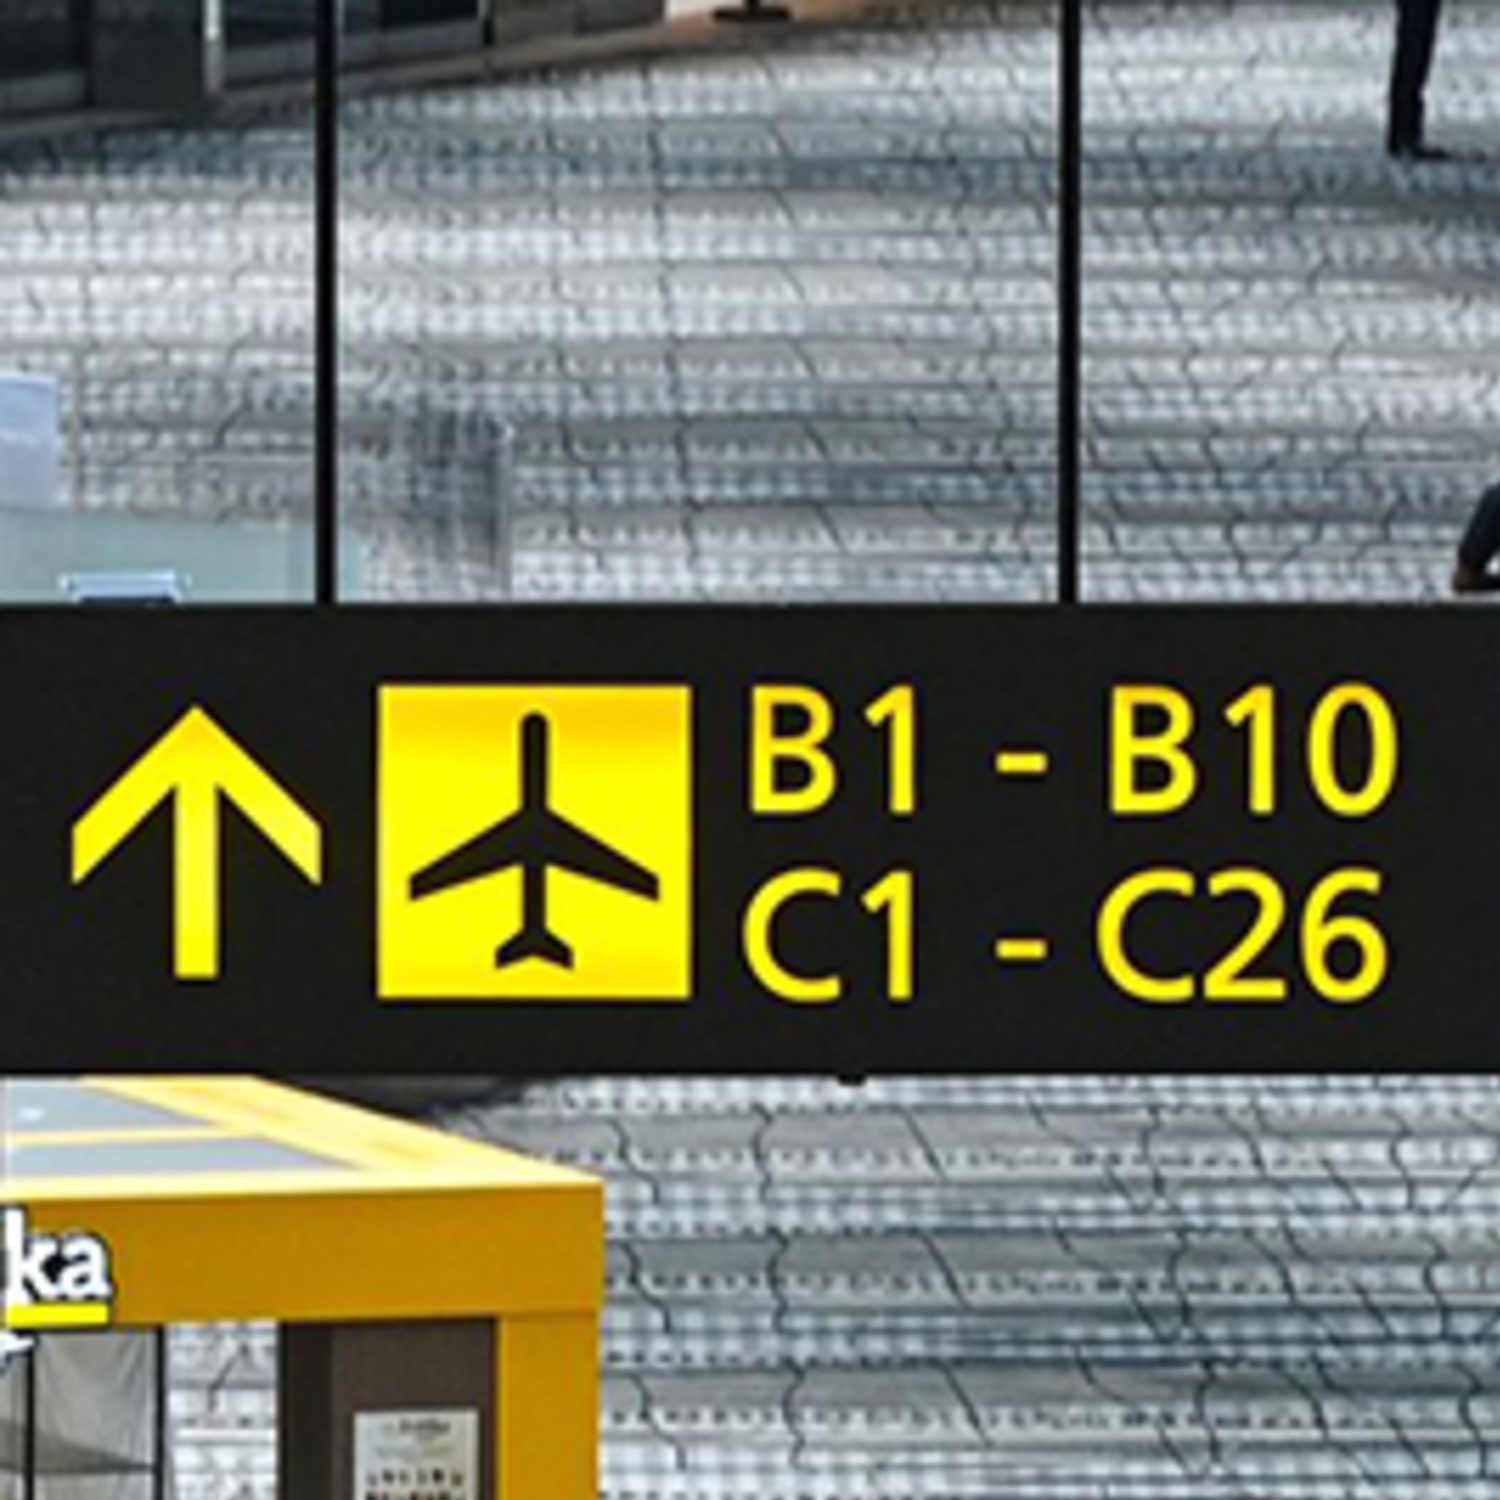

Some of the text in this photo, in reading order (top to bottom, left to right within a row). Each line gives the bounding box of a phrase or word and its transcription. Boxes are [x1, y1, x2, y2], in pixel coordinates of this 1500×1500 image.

[750, 683, 1398, 816] B1 - B10
[742, 867, 1387, 1003] C1 - C26
[5, 1207, 112, 1301] ka
